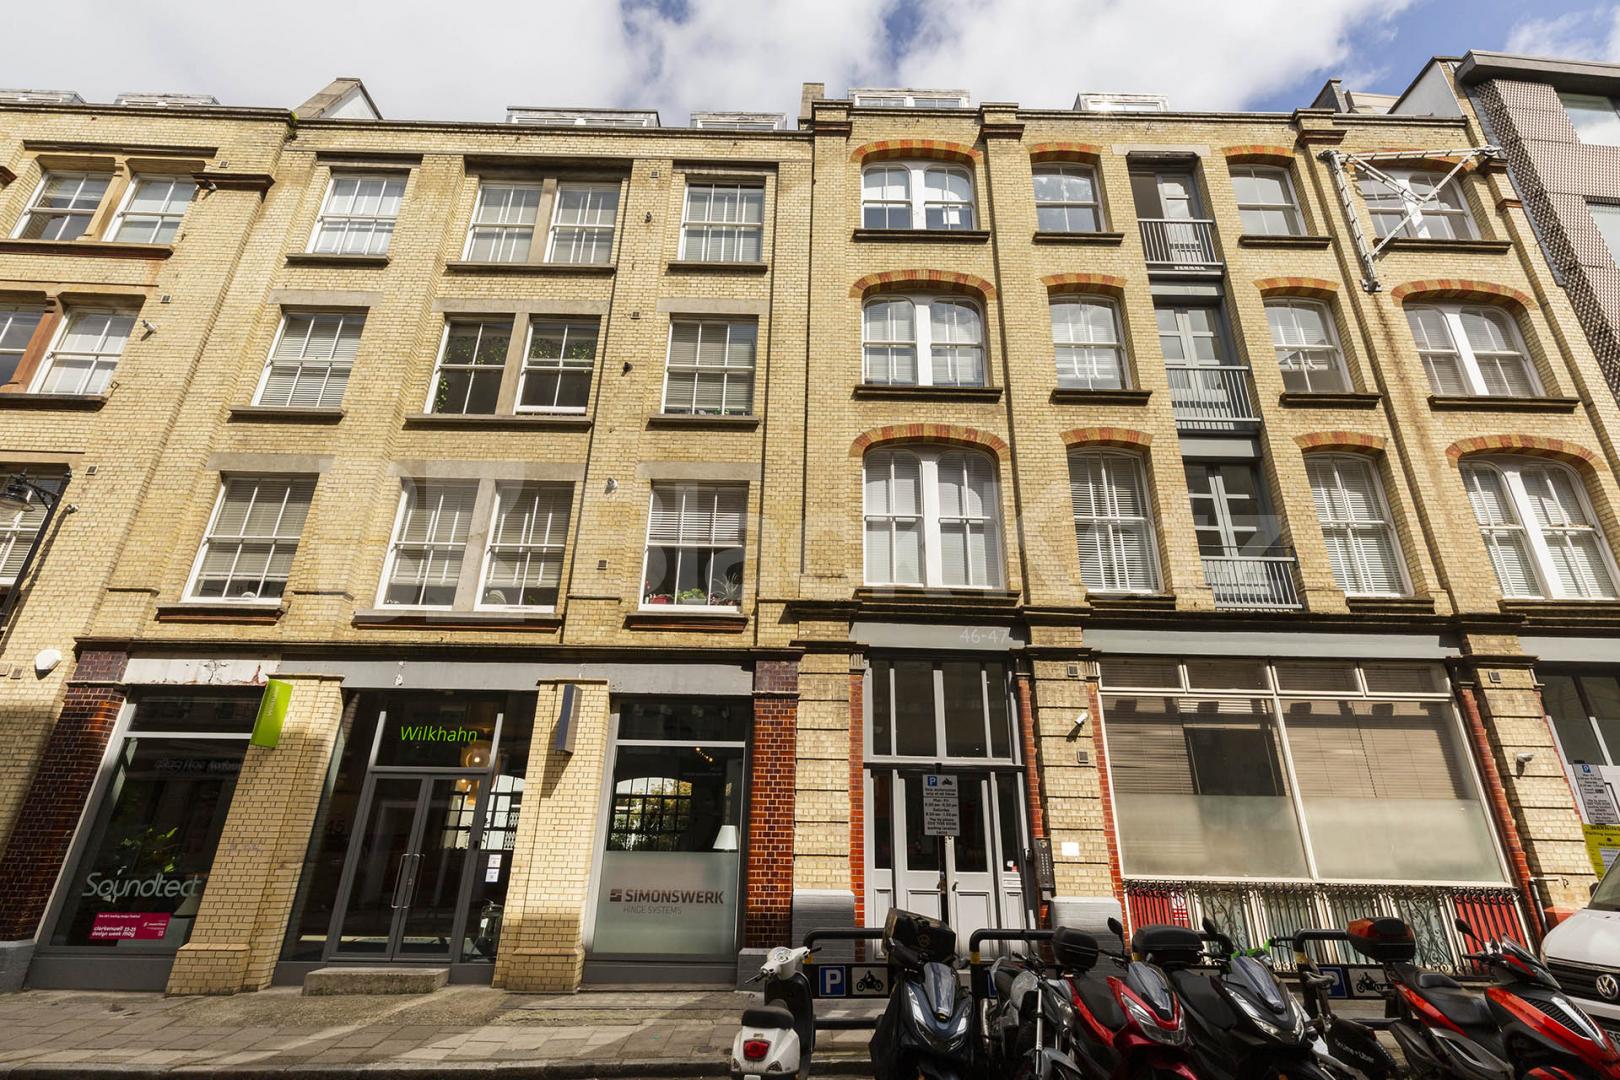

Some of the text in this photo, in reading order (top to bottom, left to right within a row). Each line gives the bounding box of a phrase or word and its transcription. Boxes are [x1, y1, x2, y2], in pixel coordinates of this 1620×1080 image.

[960, 628, 1008, 644] 46-47
[400, 725, 478, 742] Wilkhahn
[82, 872, 202, 898] Soundtect
[624, 889, 724, 904] SIMONSWERK
[623, 904, 682, 915] HINGE SYSTEMS
[825, 969, 841, 993] P
